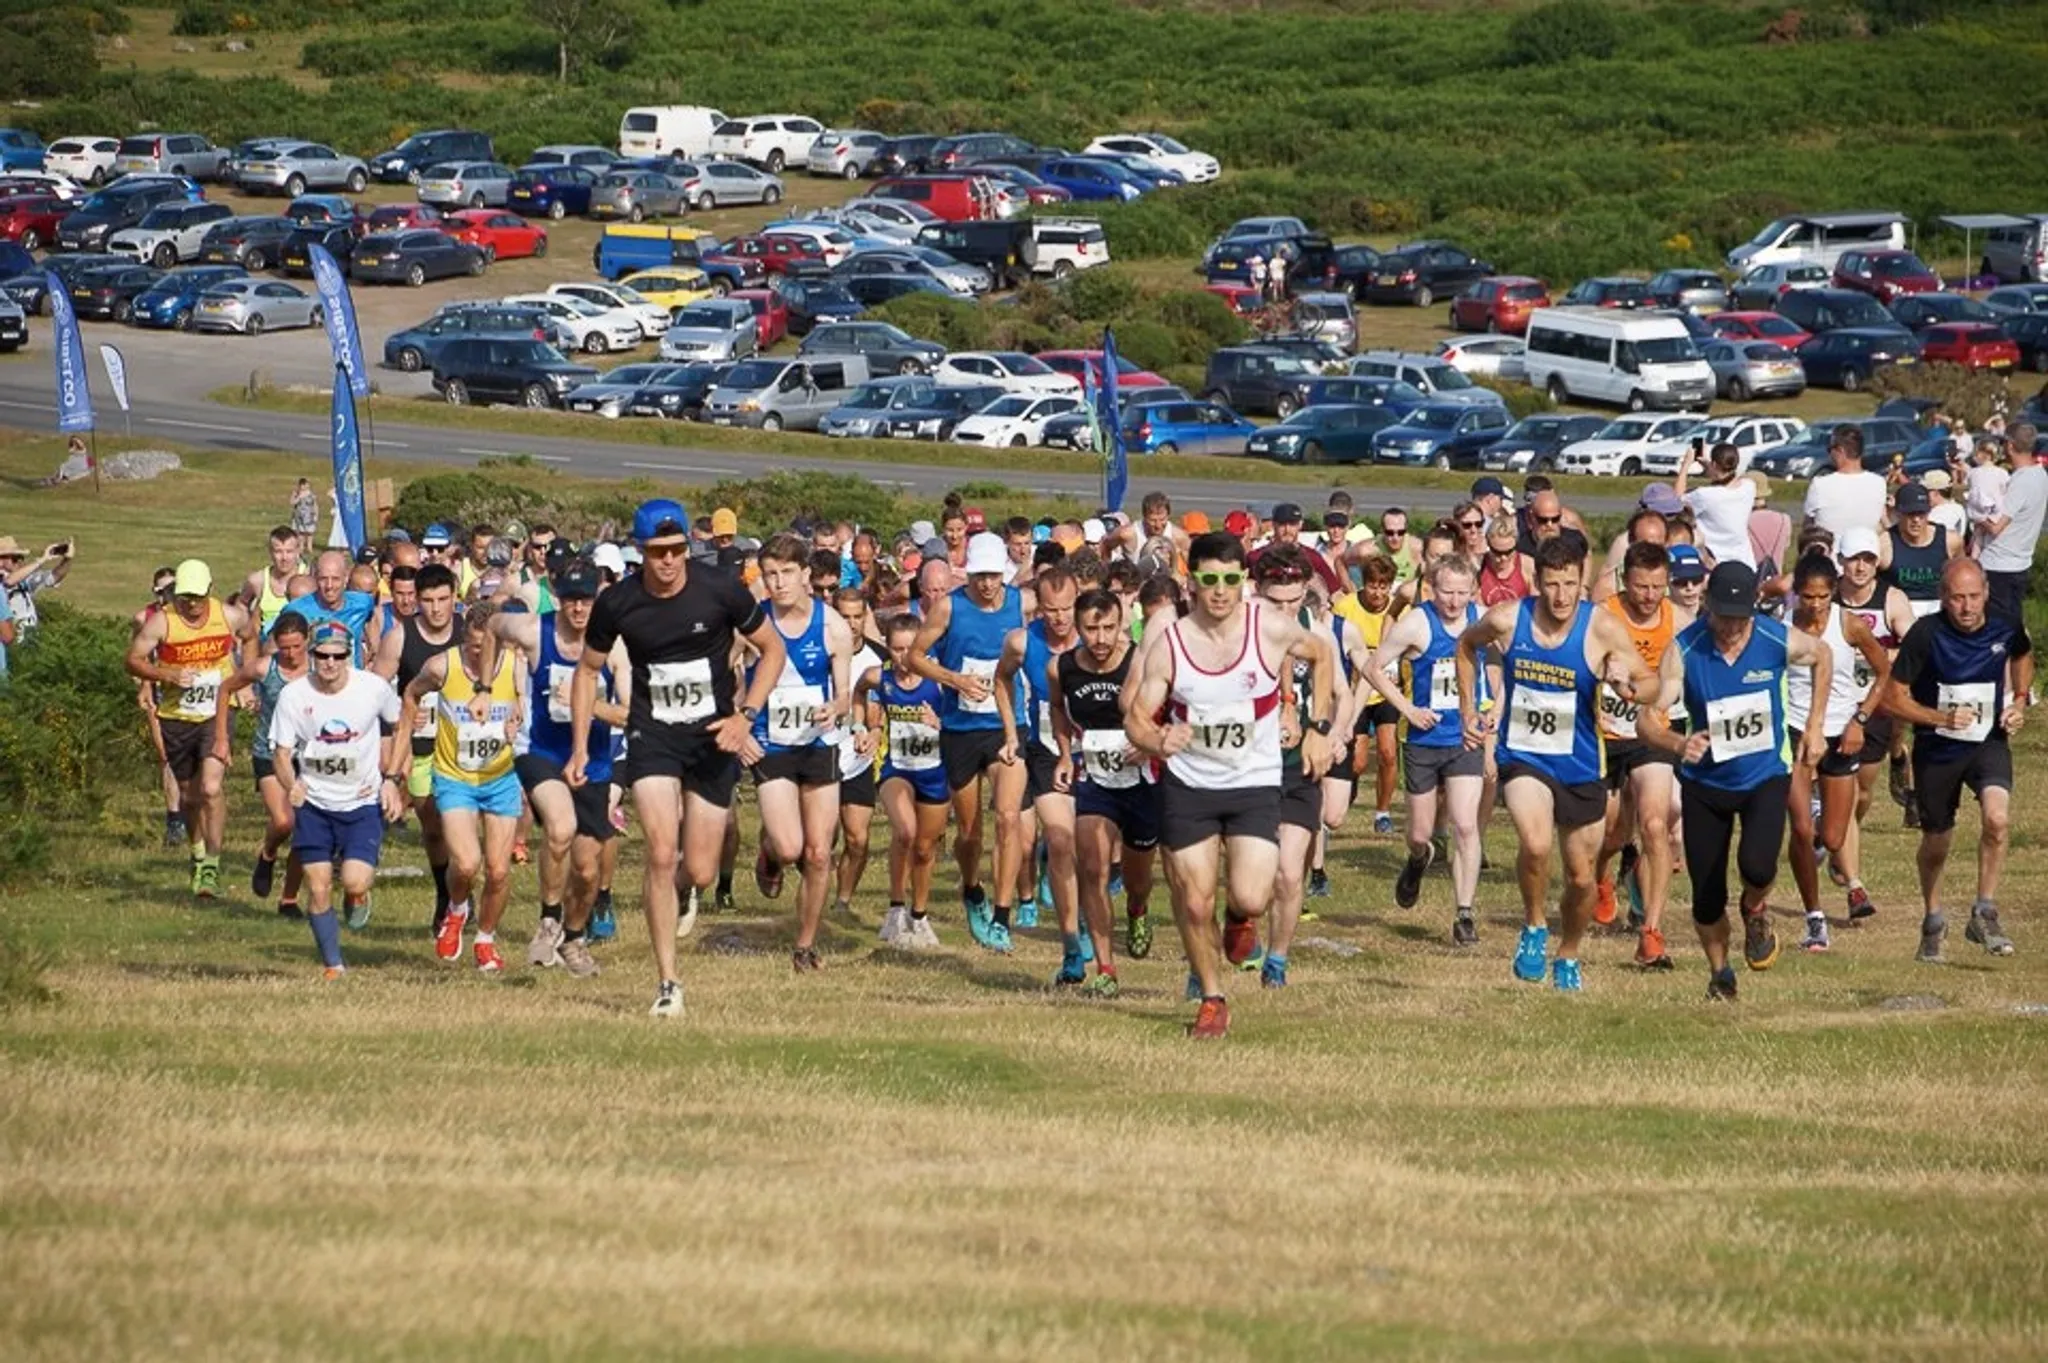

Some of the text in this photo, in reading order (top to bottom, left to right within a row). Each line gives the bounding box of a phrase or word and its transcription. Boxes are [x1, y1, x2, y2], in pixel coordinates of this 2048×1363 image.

[175, 640, 225, 657] TORBAY
[1514, 658, 1576, 680] EXMOUTH
[184, 685, 216, 704] 324
[661, 682, 704, 708] 195
[1074, 682, 1122, 699] TAVISTOC
[778, 705, 817, 729] 214
[1600, 696, 1639, 722] 306
[1526, 710, 1557, 736] 98
[1723, 712, 1764, 742] 165
[902, 735, 933, 757] 166
[1203, 723, 1246, 748] 173
[468, 737, 500, 759] 189
[315, 757, 348, 776] 154
[1098, 750, 1124, 772] 83
